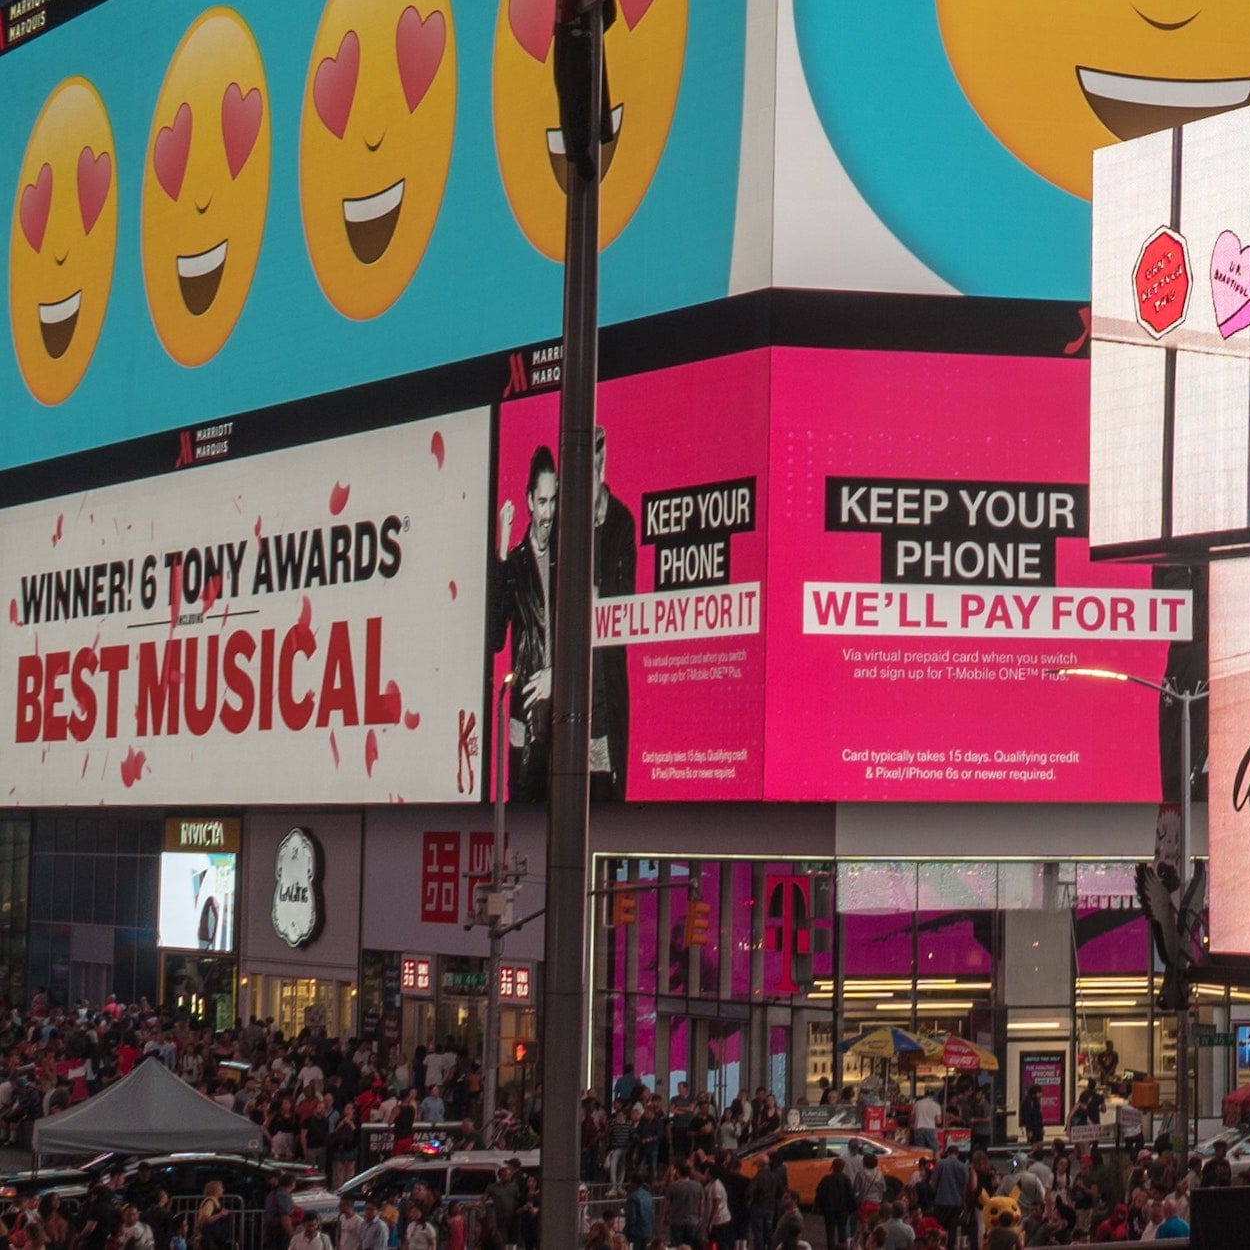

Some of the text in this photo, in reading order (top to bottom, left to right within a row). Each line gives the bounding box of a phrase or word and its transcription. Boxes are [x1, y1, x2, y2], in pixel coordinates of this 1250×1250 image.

[8, 10, 46, 42] MARQUIS
[532, 345, 564, 365] MARRI
[532, 366, 561, 386] MARQ
[646, 487, 750, 537] KEEP YOUR
[840, 486, 1076, 529] KEEP YOUR
[659, 542, 725, 585] PHONE
[896, 540, 1041, 579] PHONE
[20, 558, 134, 625] WINNER!
[140, 558, 157, 610] 6
[164, 540, 248, 607] TONY
[594, 590, 757, 640] WE'LL PAY FOR IT
[812, 590, 1186, 633] WE'LL PAY FOR IT
[843, 649, 1077, 666] Via virtual prepaid card when you switch
[854, 667, 877, 679] and
[880, 666, 905, 681] sign
[908, 669, 924, 681] up
[926, 667, 943, 679] for
[946, 667, 996, 679] T-Mobile
[14, 616, 402, 744] BEST MUSICAL
[842, 749, 1080, 765] Card typically takes 15 days. Qualifying credit
[865, 767, 1057, 782] & Pixel/iPhone 6s or newer required.
[180, 821, 224, 847] INVICTA
[472, 843, 496, 872] UN
